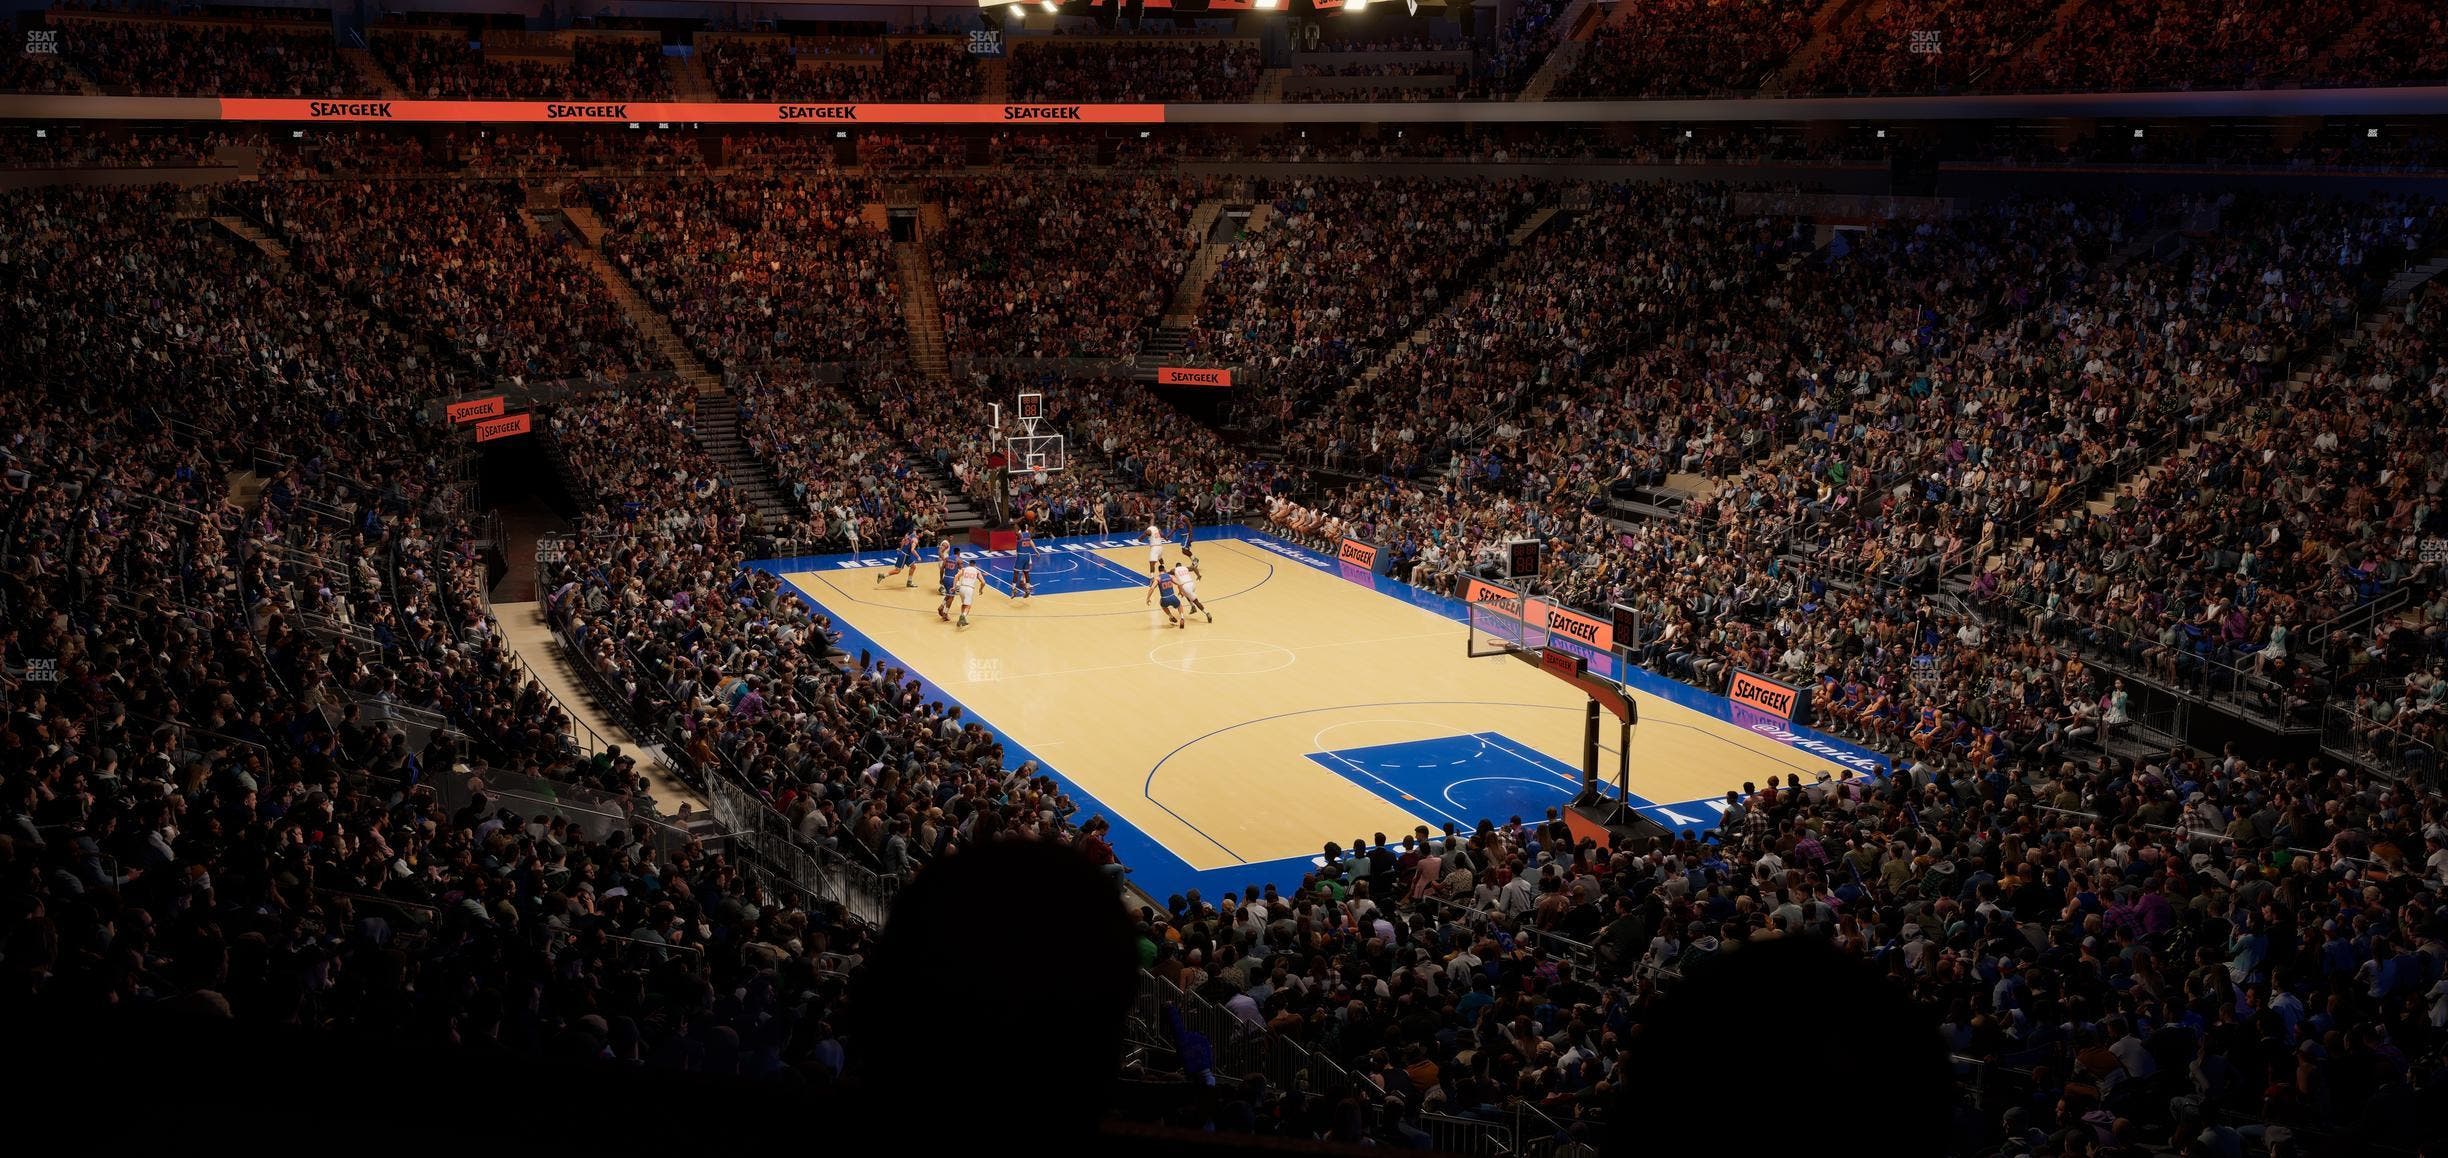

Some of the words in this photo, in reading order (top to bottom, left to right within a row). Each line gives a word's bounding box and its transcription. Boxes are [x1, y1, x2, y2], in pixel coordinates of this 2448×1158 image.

[310, 102, 392, 117] SEATGEEK
[547, 104, 627, 119] SEATGEEK
[779, 106, 857, 119] SEATGEEK
[1004, 106, 1080, 120] SEATGEEK
[1171, 372, 1219, 384] SEATGEEK
[456, 402, 494, 419] SEATGEEK
[485, 420, 520, 438] SEATGEEK
[1342, 543, 1373, 567] SEATGEEK
[1548, 610, 1599, 644] SEATGEEK
[1546, 653, 1572, 671] SEATGEEK
[1735, 679, 1791, 714] SEATGEEK
